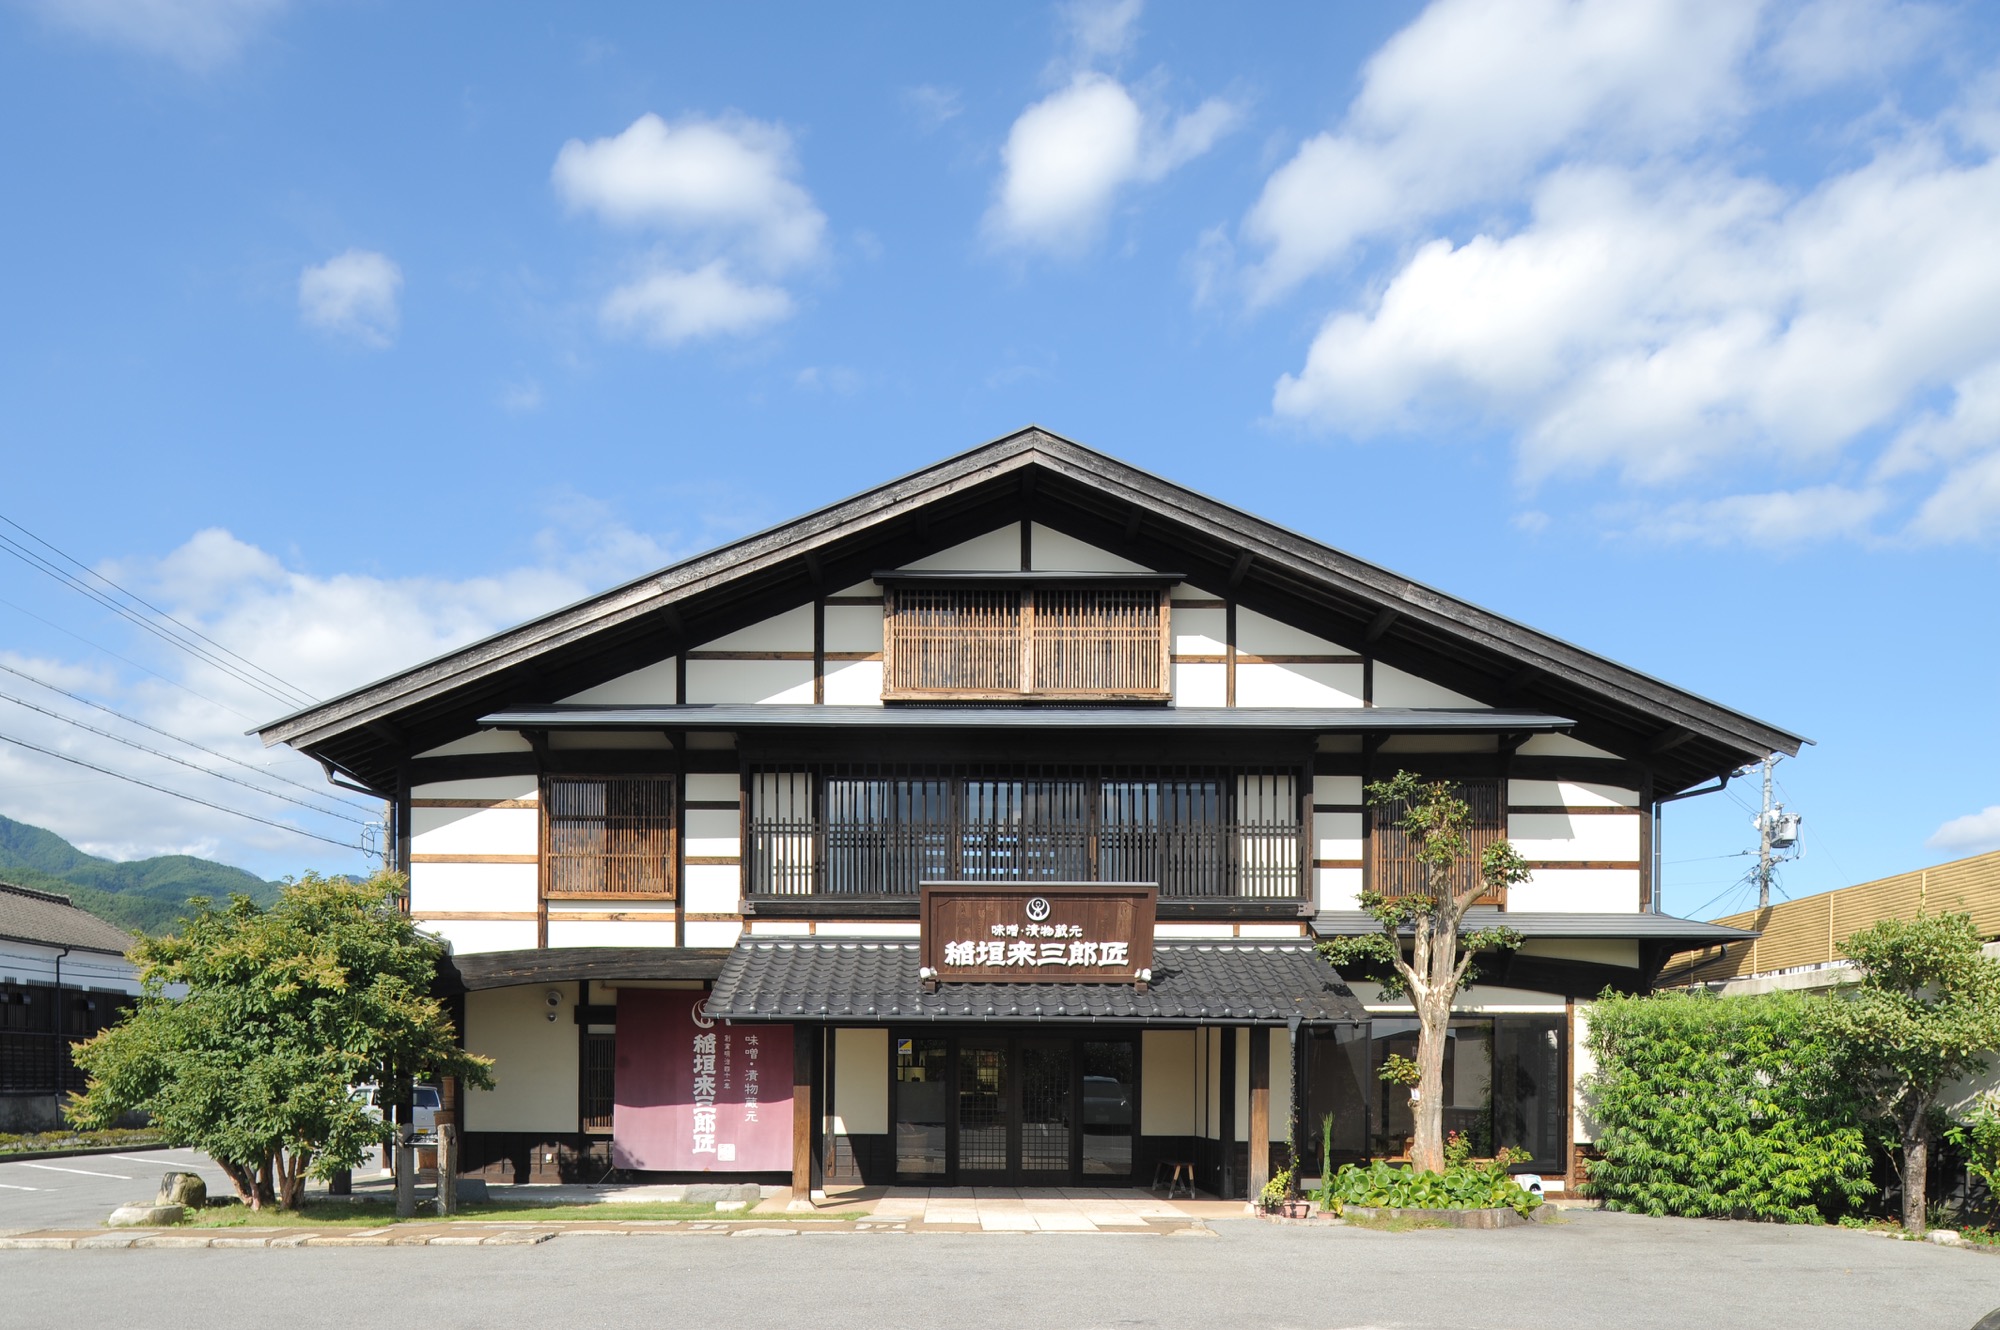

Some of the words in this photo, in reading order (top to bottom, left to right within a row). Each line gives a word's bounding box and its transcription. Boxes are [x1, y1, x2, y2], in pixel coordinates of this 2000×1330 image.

[944, 940, 1129, 967] 稲垣来三郎匠
[692, 1033, 717, 1154] 稲垣来三郎匠
